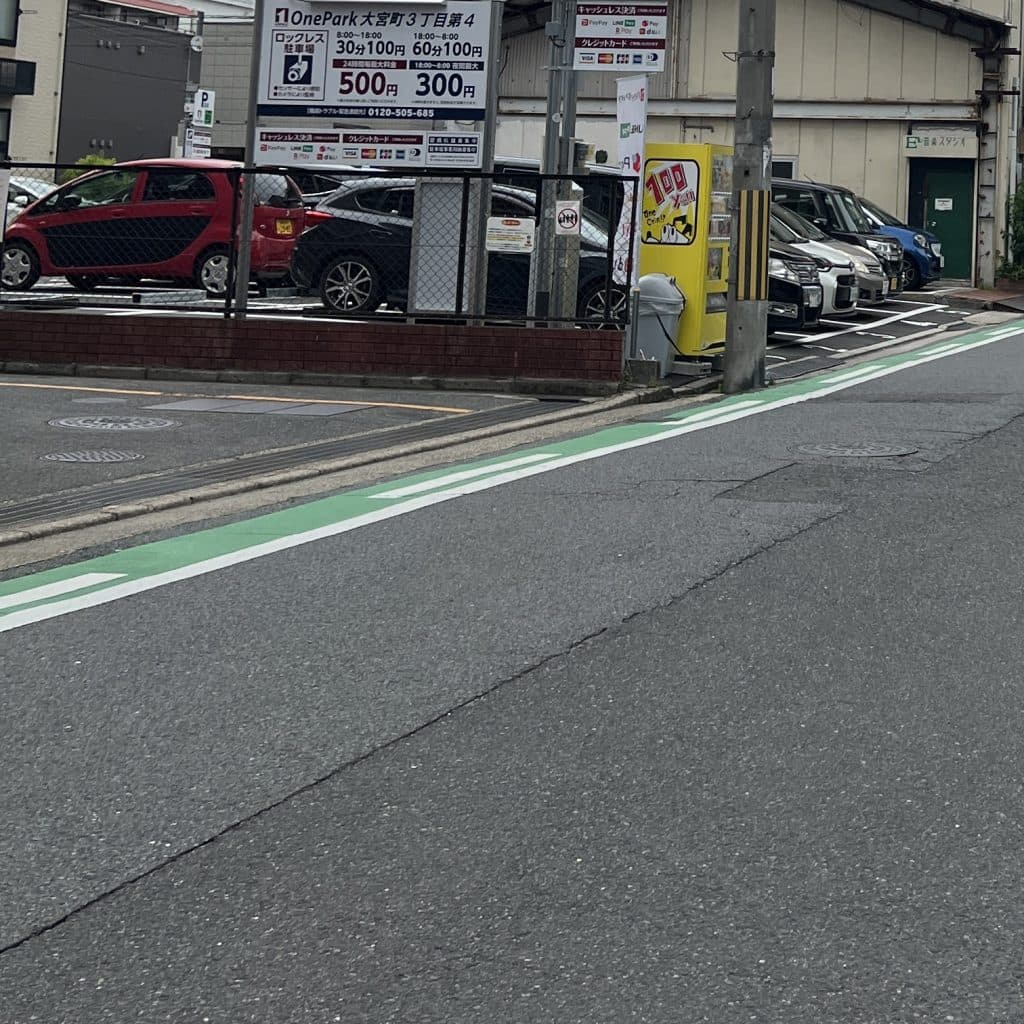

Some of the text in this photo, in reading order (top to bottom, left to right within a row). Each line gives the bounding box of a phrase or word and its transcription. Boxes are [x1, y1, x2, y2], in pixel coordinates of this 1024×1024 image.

[275, 32, 325, 43] ロックレス
[284, 44, 314, 54] 駐車場
[336, 40, 405, 56] 30分100円
[413, 41, 482, 57] 60分100円
[339, 71, 398, 96] 500円
[415, 73, 475, 98] 300円
[368, 108, 434, 117] 0120-505-685
